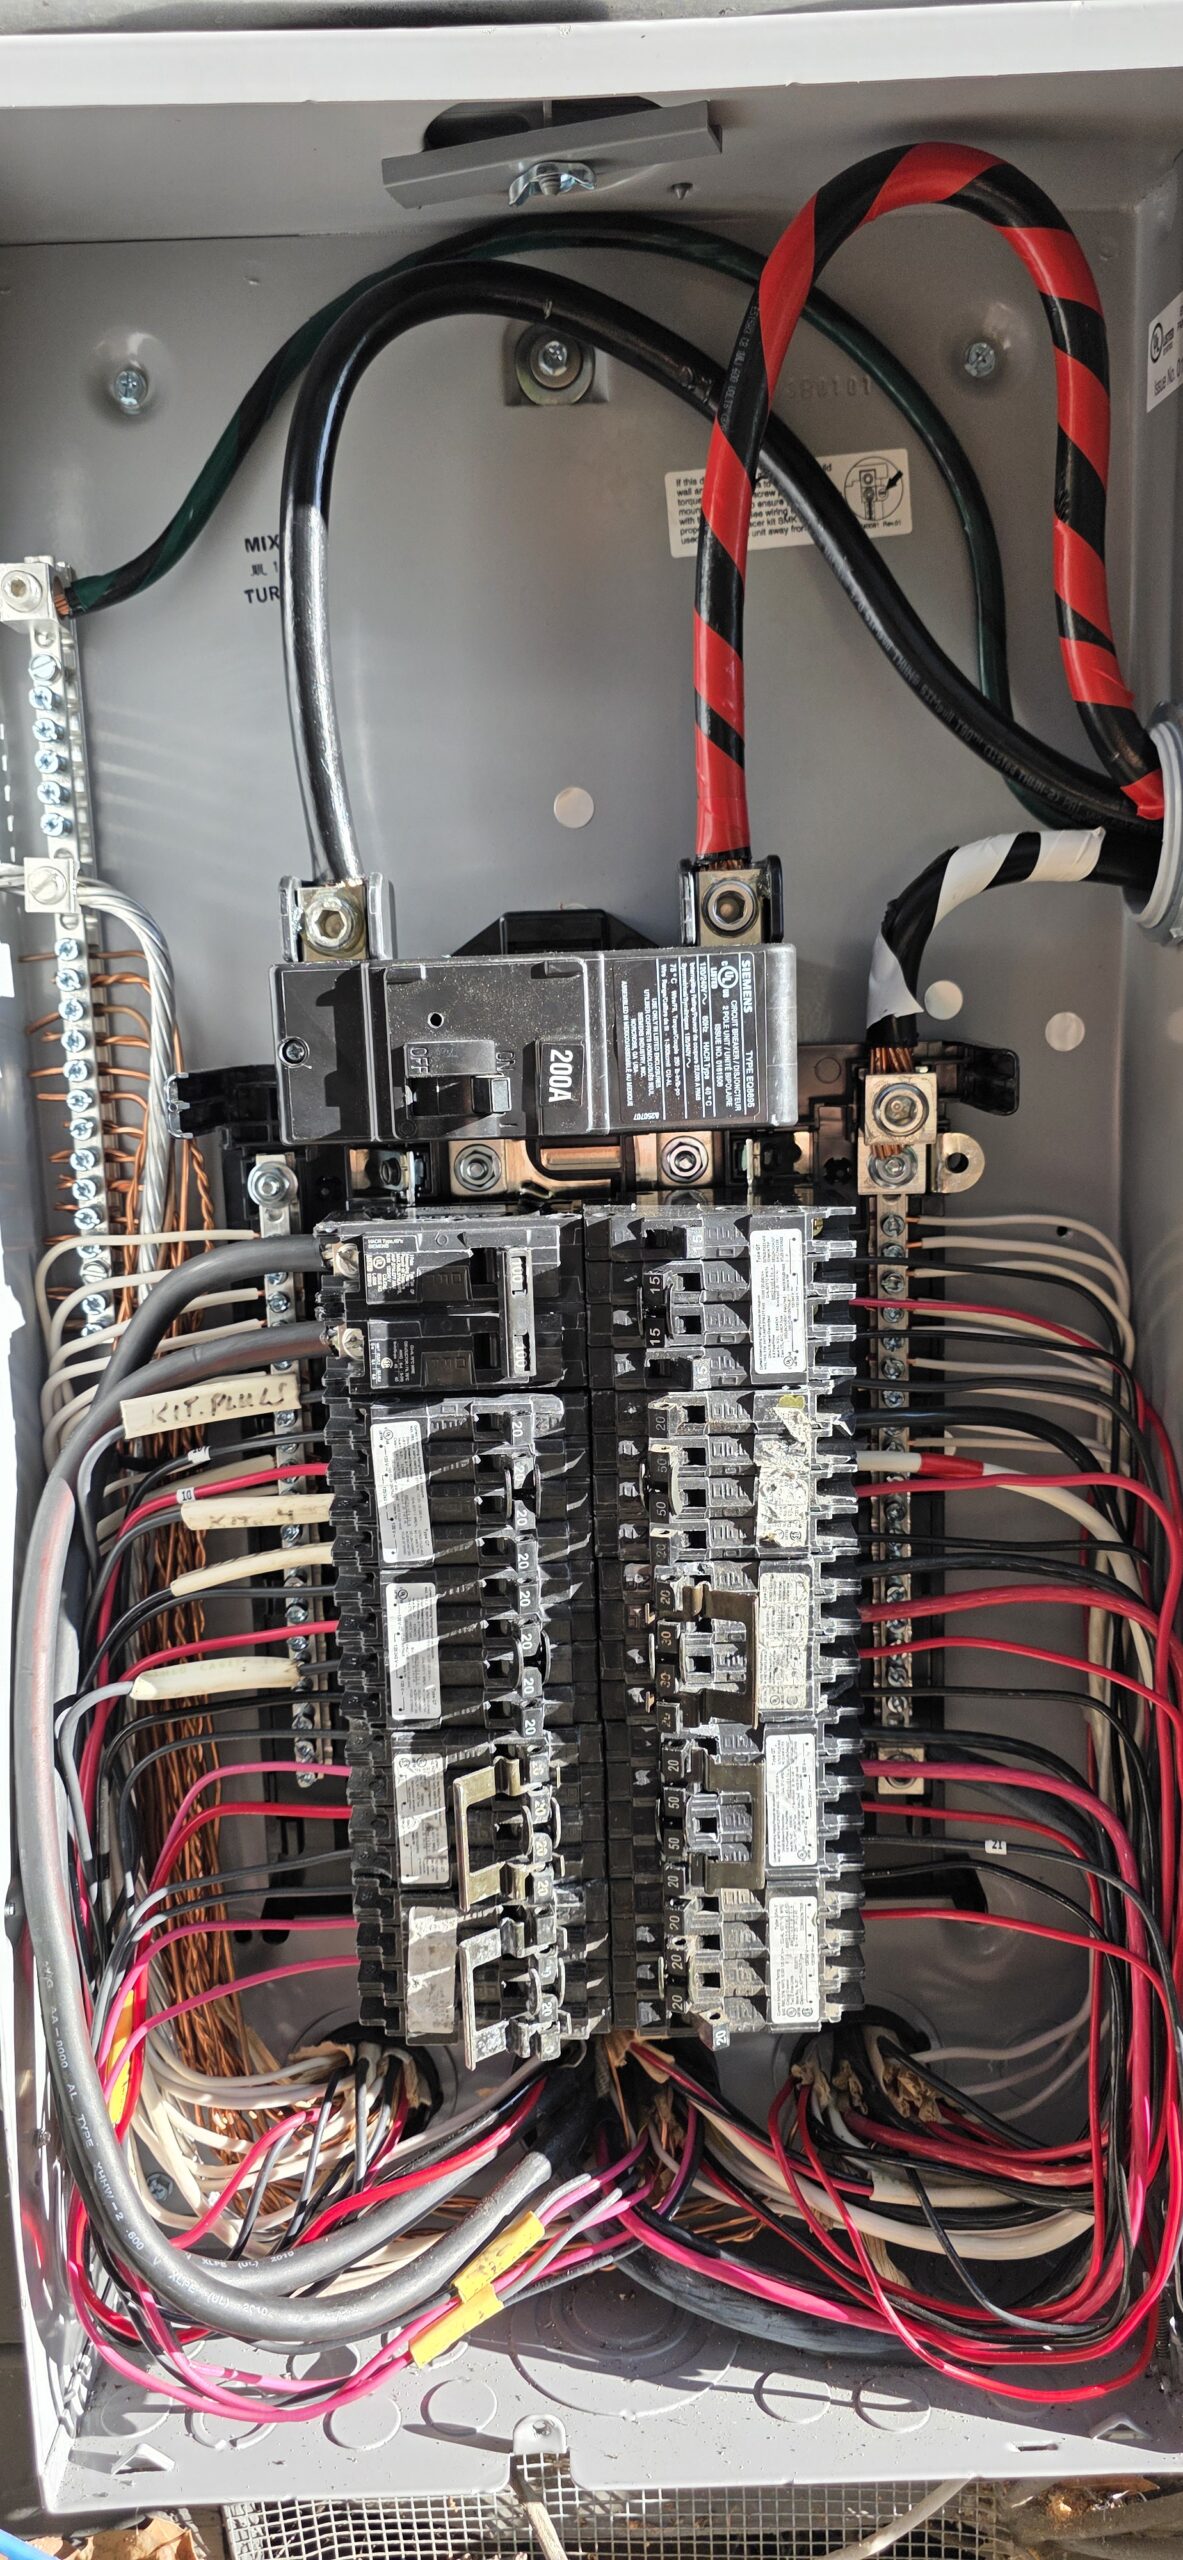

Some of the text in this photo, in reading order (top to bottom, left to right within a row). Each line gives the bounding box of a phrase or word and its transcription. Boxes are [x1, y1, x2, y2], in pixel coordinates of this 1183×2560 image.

[742, 960, 752, 1013] SIEMENS
[702, 1042, 710, 1061] HACR
[731, 1029, 739, 1059] BREAKER
[410, 1047, 429, 1074] OFF
[548, 1049, 574, 1103] 200A
[703, 1063, 711, 1079] Type
[733, 1065, 741, 1111] DISJONCTEUR
[692, 1234, 704, 1254] 15
[650, 1276, 661, 1294] 15
[650, 1327, 661, 1346] 15
[697, 1365, 708, 1384] 15
[512, 1421, 523, 1437] 20
[655, 1416, 666, 1431] 20
[657, 1458, 667, 1473] 50
[514, 1466, 525, 1484] 20
[181, 1490, 191, 1501] 10
[656, 1501, 667, 1516] 50
[516, 1510, 528, 1526] 20
[518, 1553, 529, 1569] 20
[520, 1591, 531, 1607] 20
[660, 1589, 671, 1605] 20
[522, 1633, 533, 1650] 20
[660, 1631, 672, 1646] 30
[524, 1678, 534, 1694] 20
[660, 1672, 671, 1688] 30
[525, 1719, 536, 1735] 20
[668, 1760, 679, 1772] 20
[535, 1800, 546, 1816] 20
[668, 1796, 680, 1809] 50
[536, 1840, 548, 1856] 20
[668, 1837, 680, 1850] 50
[538, 1880, 549, 1897] 20
[668, 1875, 679, 1888] 20
[669, 1915, 680, 1930] 20
[671, 1954, 683, 1970] 20
[542, 2002, 552, 2016] 20
[672, 1994, 683, 2011] 20
[716, 2029, 727, 2045] 20
[67, 2083, 78, 2103] AL
[78, 2113, 94, 2148] TYPE
[168, 2270, 197, 2293] XLPE
